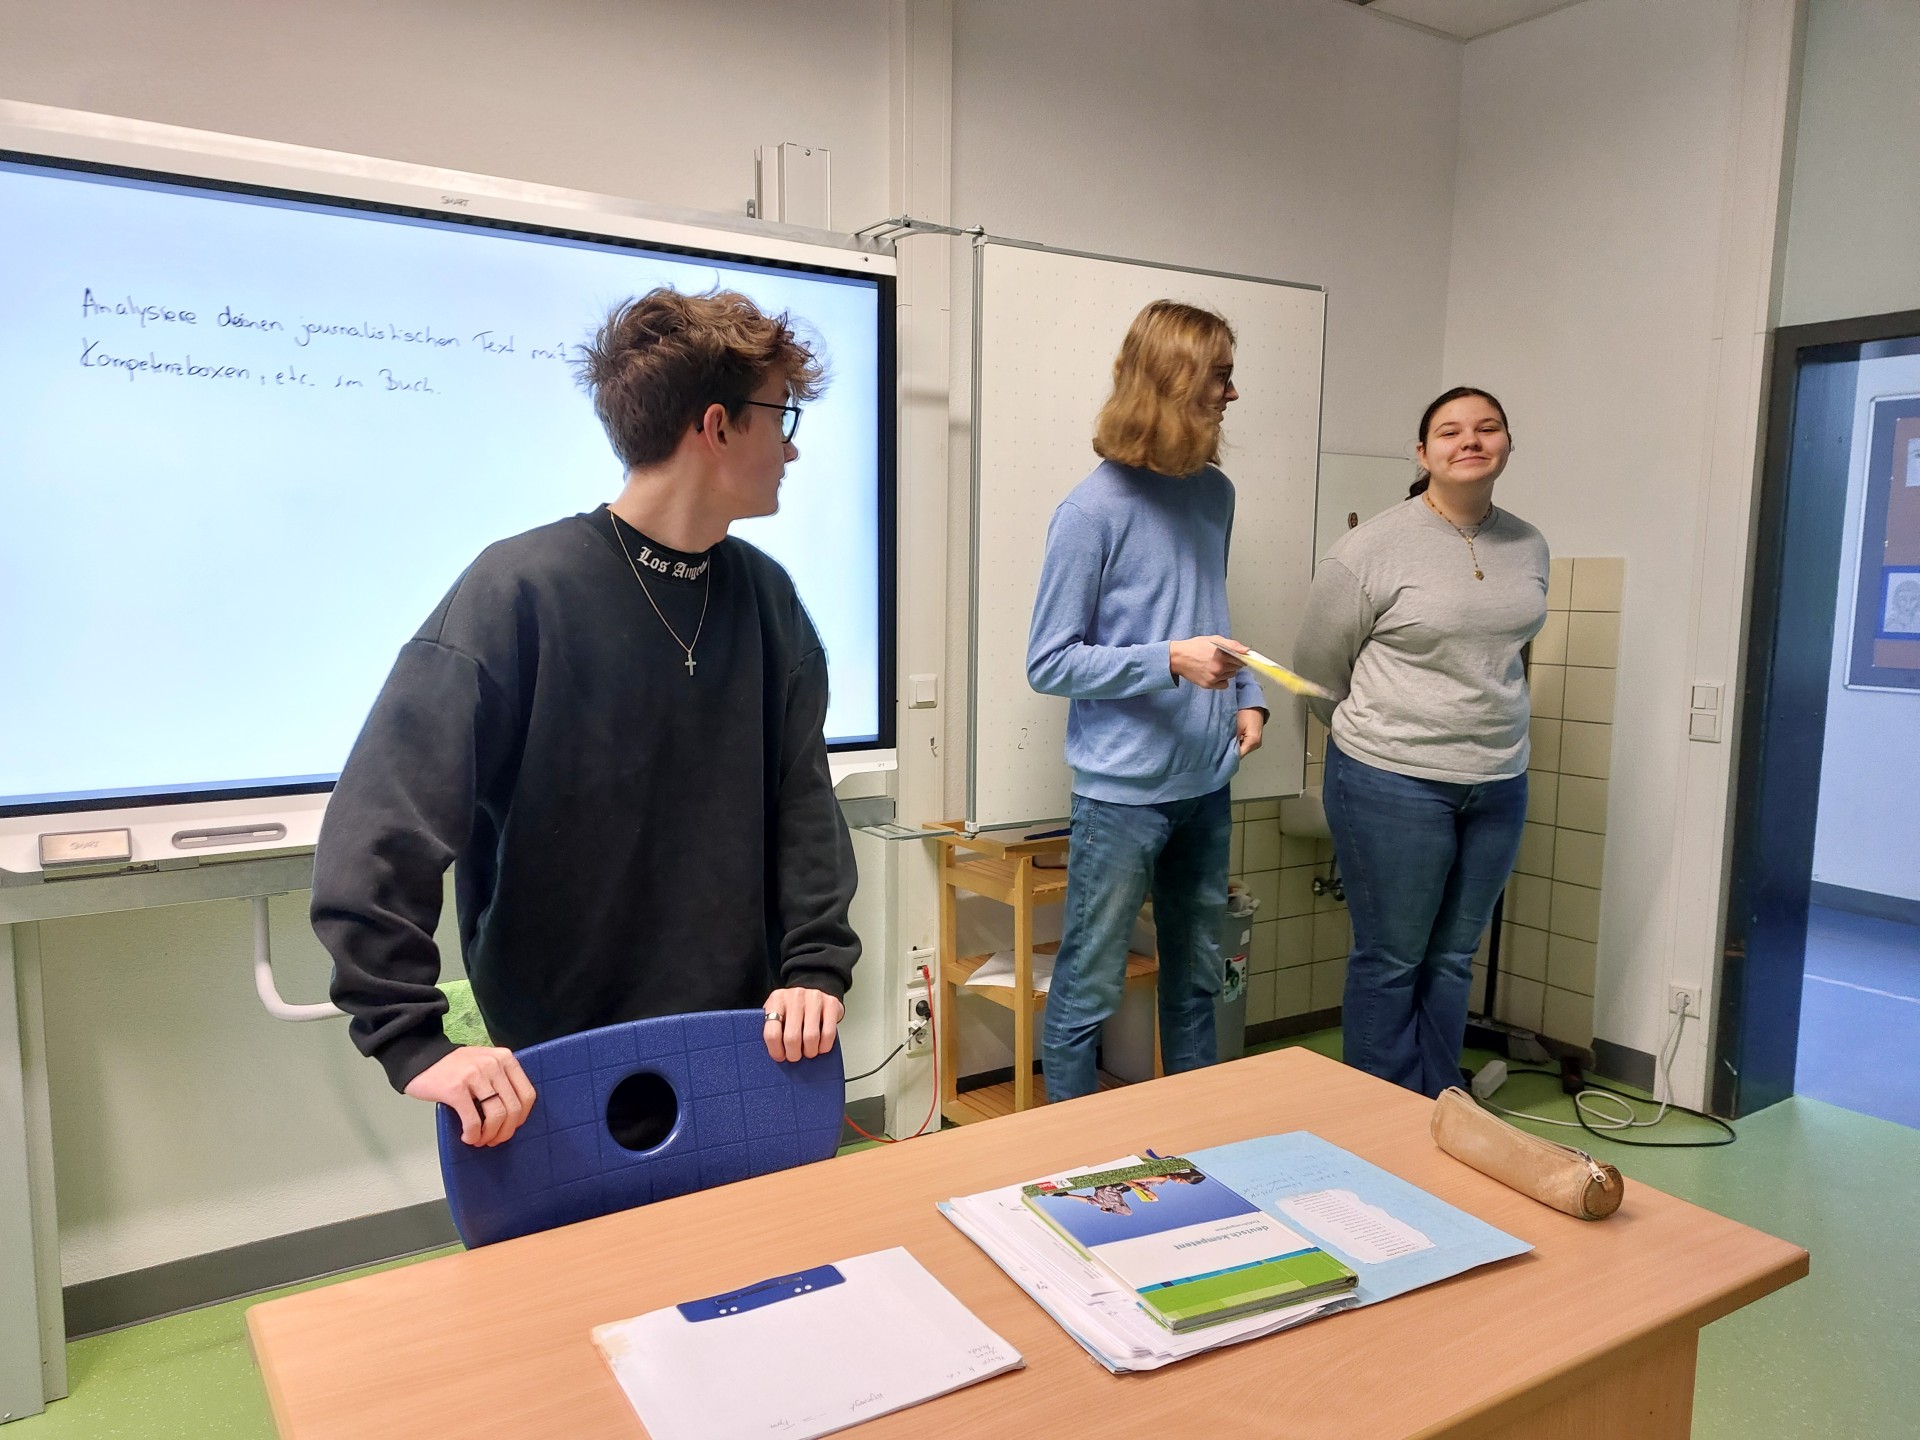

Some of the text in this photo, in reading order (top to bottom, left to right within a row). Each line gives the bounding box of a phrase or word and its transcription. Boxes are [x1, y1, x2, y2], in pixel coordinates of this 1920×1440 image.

[472, 330, 515, 354] Text
[636, 546, 671, 573] Los
[1173, 1225, 1269, 1250] deutsch.kompetent
